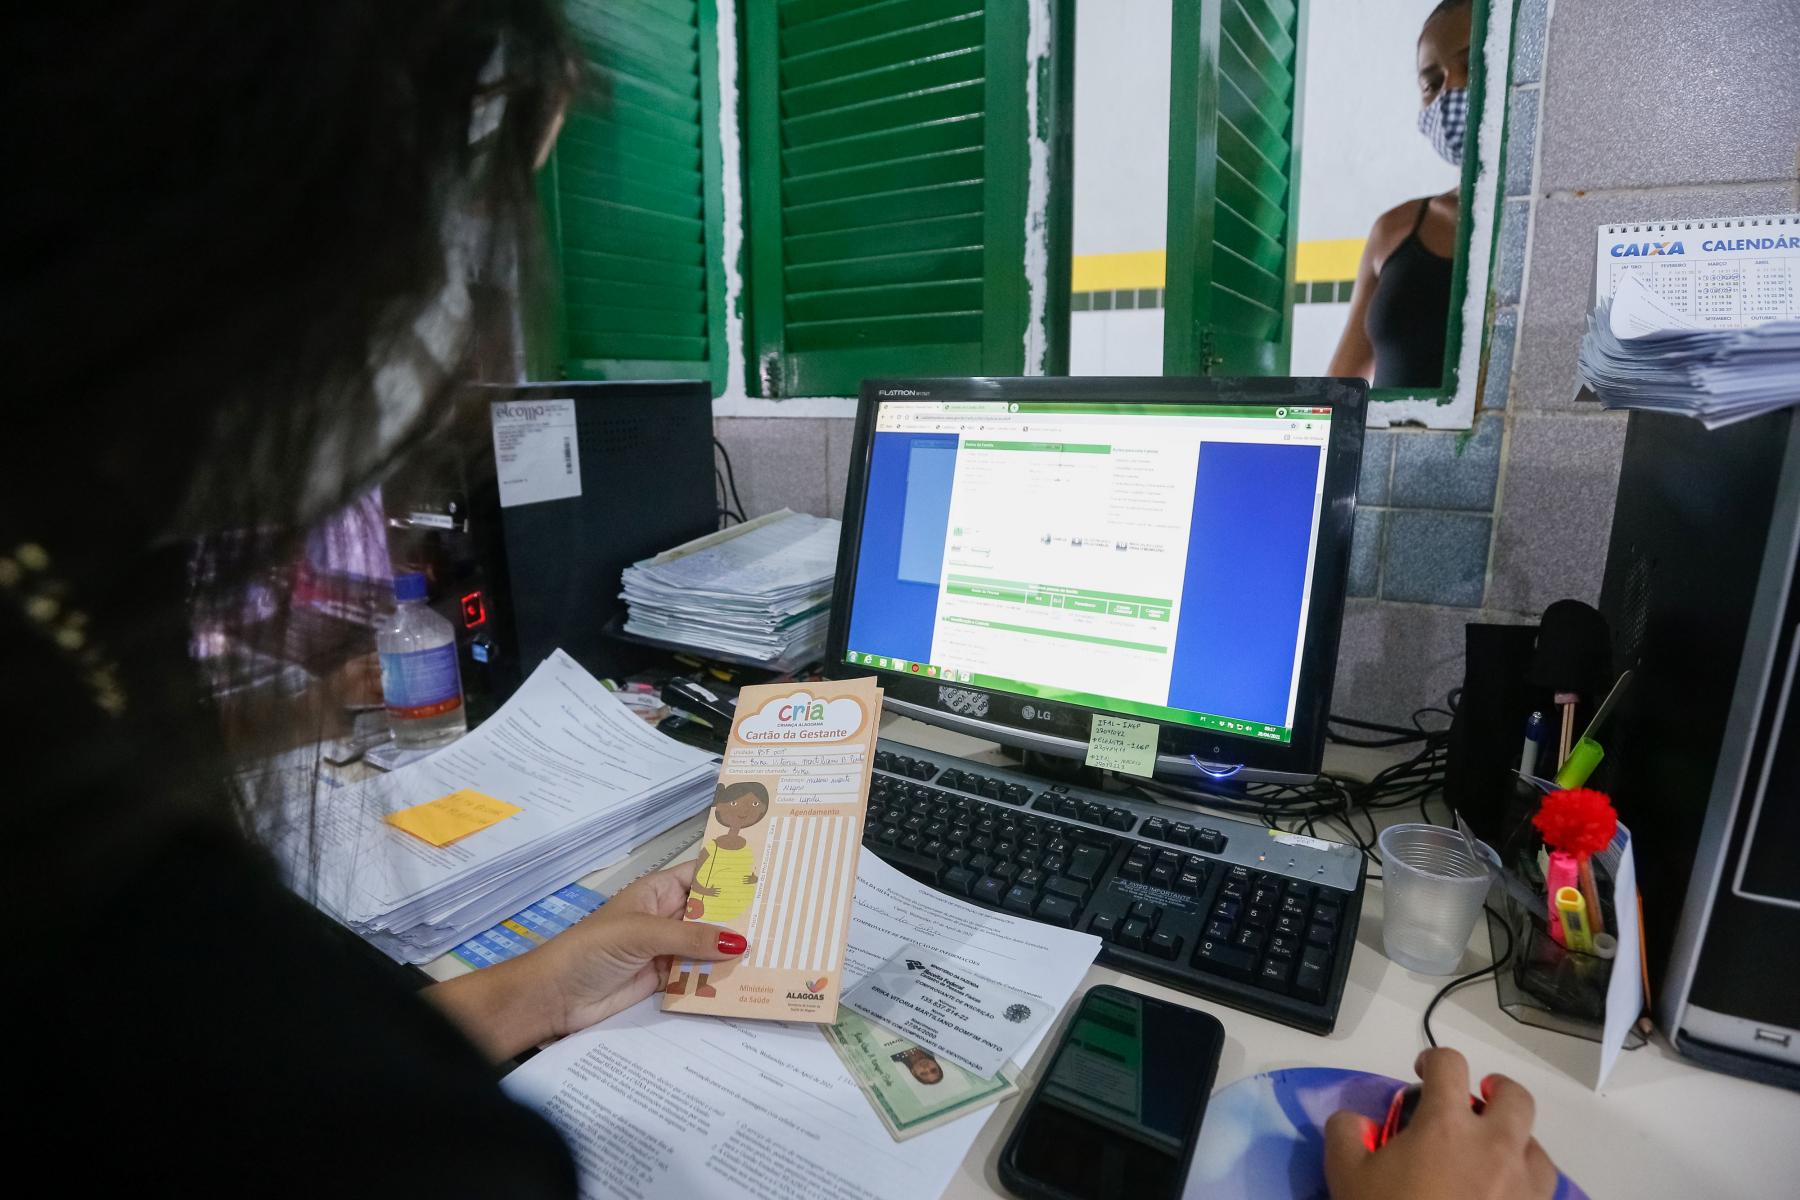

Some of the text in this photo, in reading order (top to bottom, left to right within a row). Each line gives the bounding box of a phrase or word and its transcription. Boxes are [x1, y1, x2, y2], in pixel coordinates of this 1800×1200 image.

[1610, 241, 1685, 257] CAIXA
[778, 701, 824, 722] cria
[1037, 710, 1051, 720] LG
[746, 728, 847, 740] Cartão da Gestante
[790, 808, 839, 816] Agendamento
[852, 917, 891, 934] COMPROVANTE
[923, 968, 943, 981] Receita
[943, 977, 964, 990] Federal
[959, 976, 978, 988] FAZENDA
[740, 984, 773, 993] Ministério
[786, 992, 824, 1000] ALAGOAS
[915, 977, 955, 1001] COMPROVANTE
[963, 1001, 994, 1020] INSCRIÇÃO
[871, 985, 889, 997] ERIKA
[890, 994, 914, 1009] VITORIA
[914, 1005, 953, 1028] MARTILIANO
[954, 1025, 981, 1041] BOMFIM
[981, 1039, 1002, 1052] PINTO
[931, 1008, 945, 1017] Nome
[903, 1027, 937, 1047] COMPROVANTE
[945, 1049, 983, 1071] IDENTIFICAÇÃO
